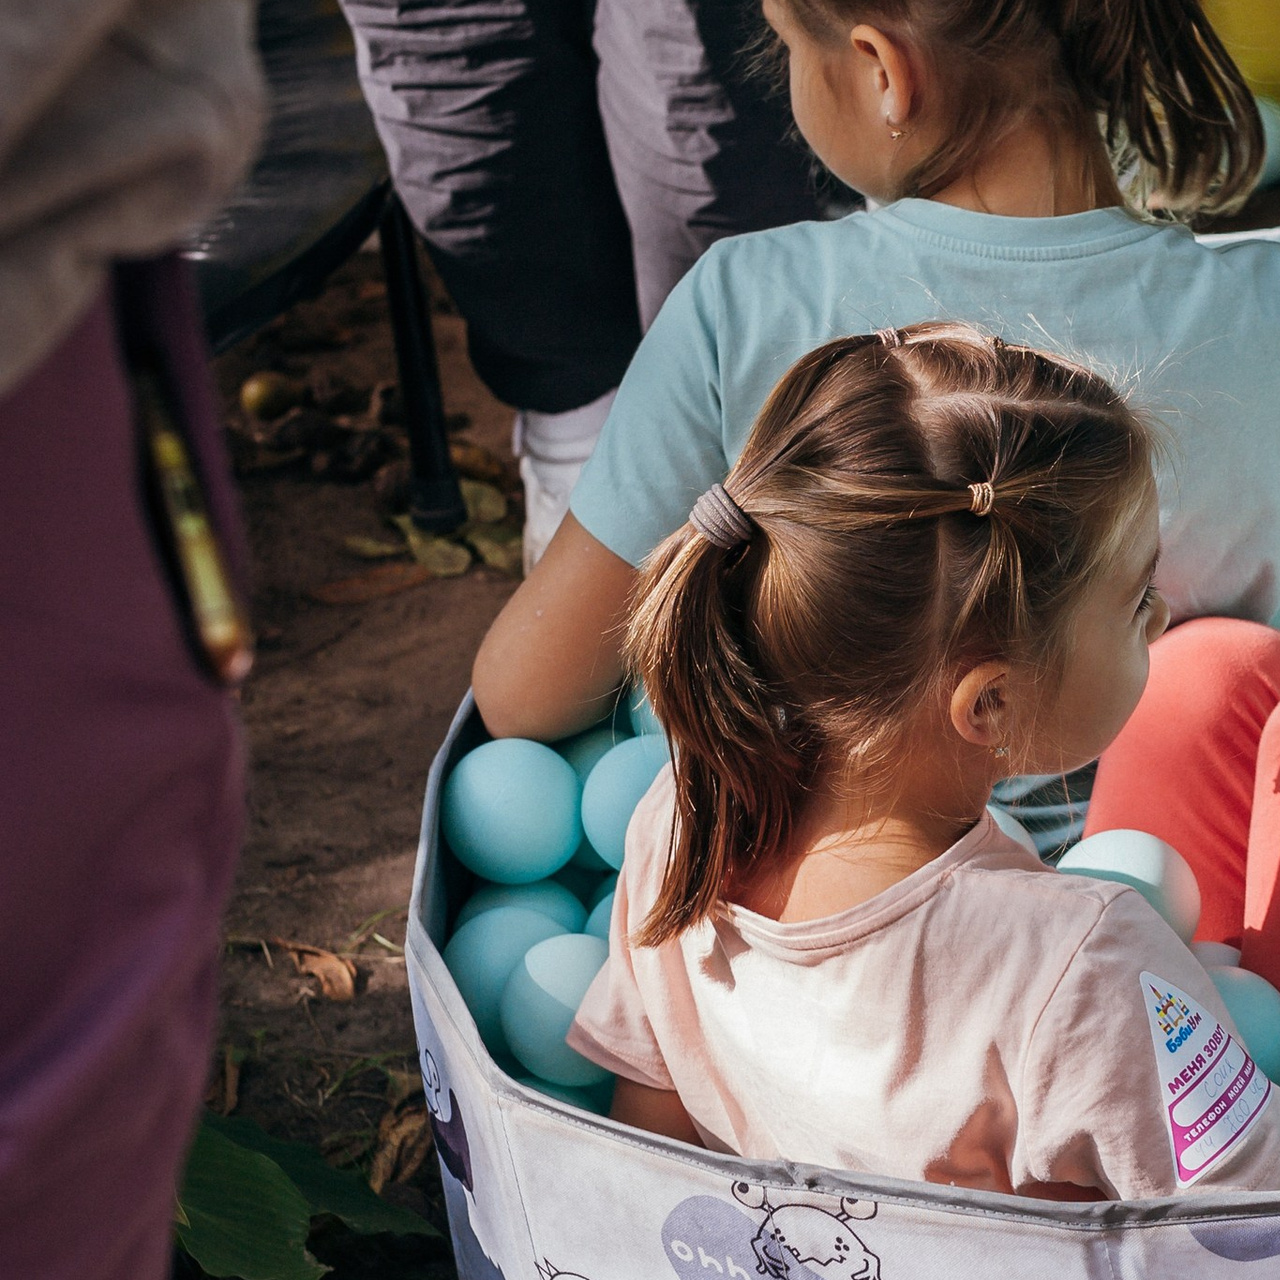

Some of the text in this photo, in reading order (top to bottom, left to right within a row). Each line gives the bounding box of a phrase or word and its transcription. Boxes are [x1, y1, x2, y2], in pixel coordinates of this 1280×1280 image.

[1167, 1023, 1225, 1095] МЕНЯ ЗОВУТ
[1183, 1101, 1227, 1142] ТЕЛЕФОН
[1227, 1075, 1246, 1100] МОЕЙ
